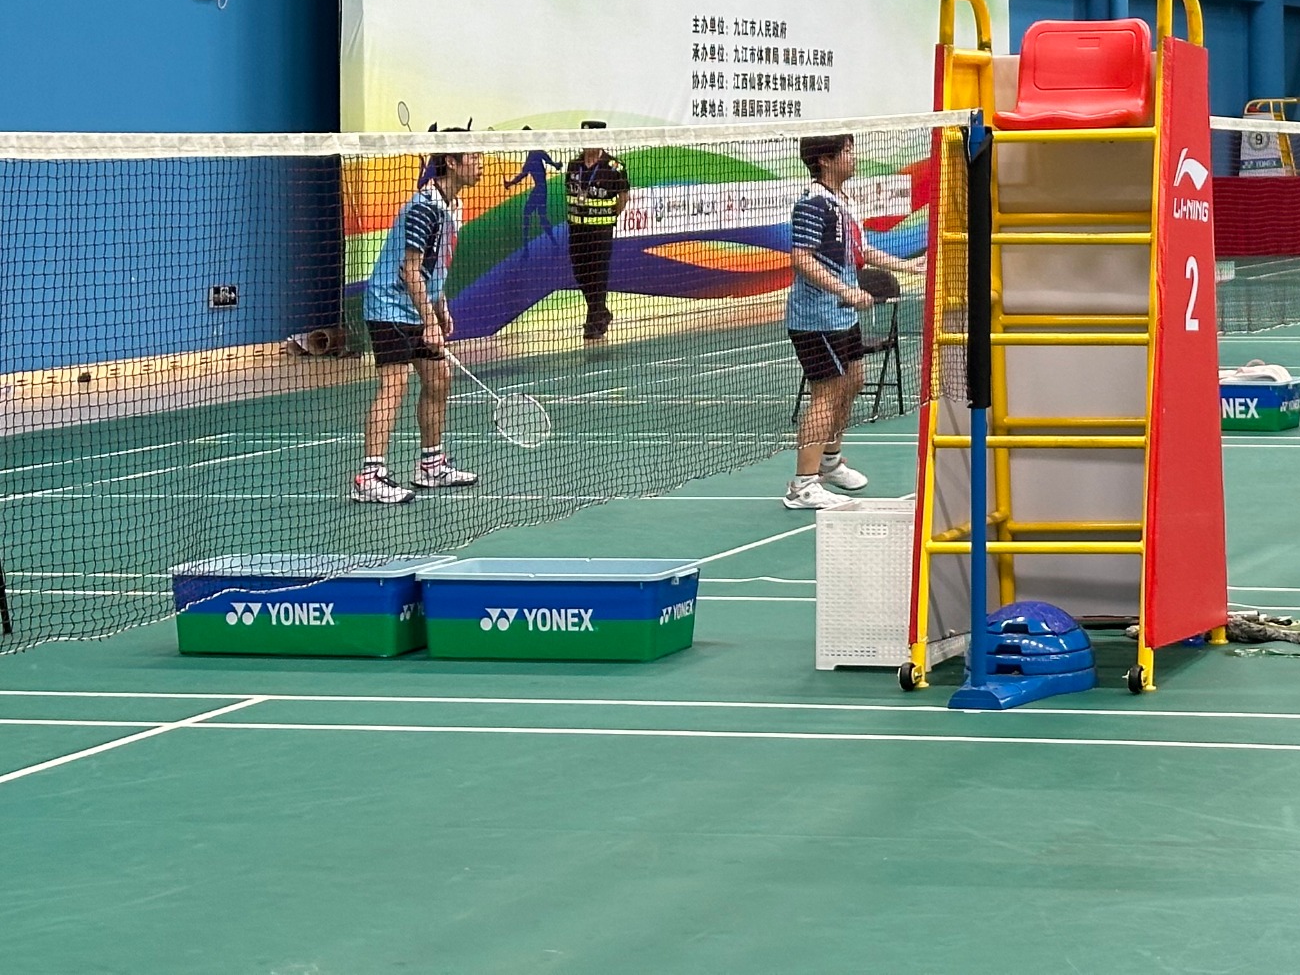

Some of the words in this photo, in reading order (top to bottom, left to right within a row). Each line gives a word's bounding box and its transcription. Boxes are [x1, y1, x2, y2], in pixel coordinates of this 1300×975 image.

[1255, 132, 1263, 145] 9
[1173, 198, 1209, 223] LI-NING
[1185, 256, 1199, 332] 2
[1221, 398, 1259, 419] NEX
[267, 603, 335, 626] YONEX
[523, 608, 594, 632] YONEX
[673, 600, 695, 620] YONEX
